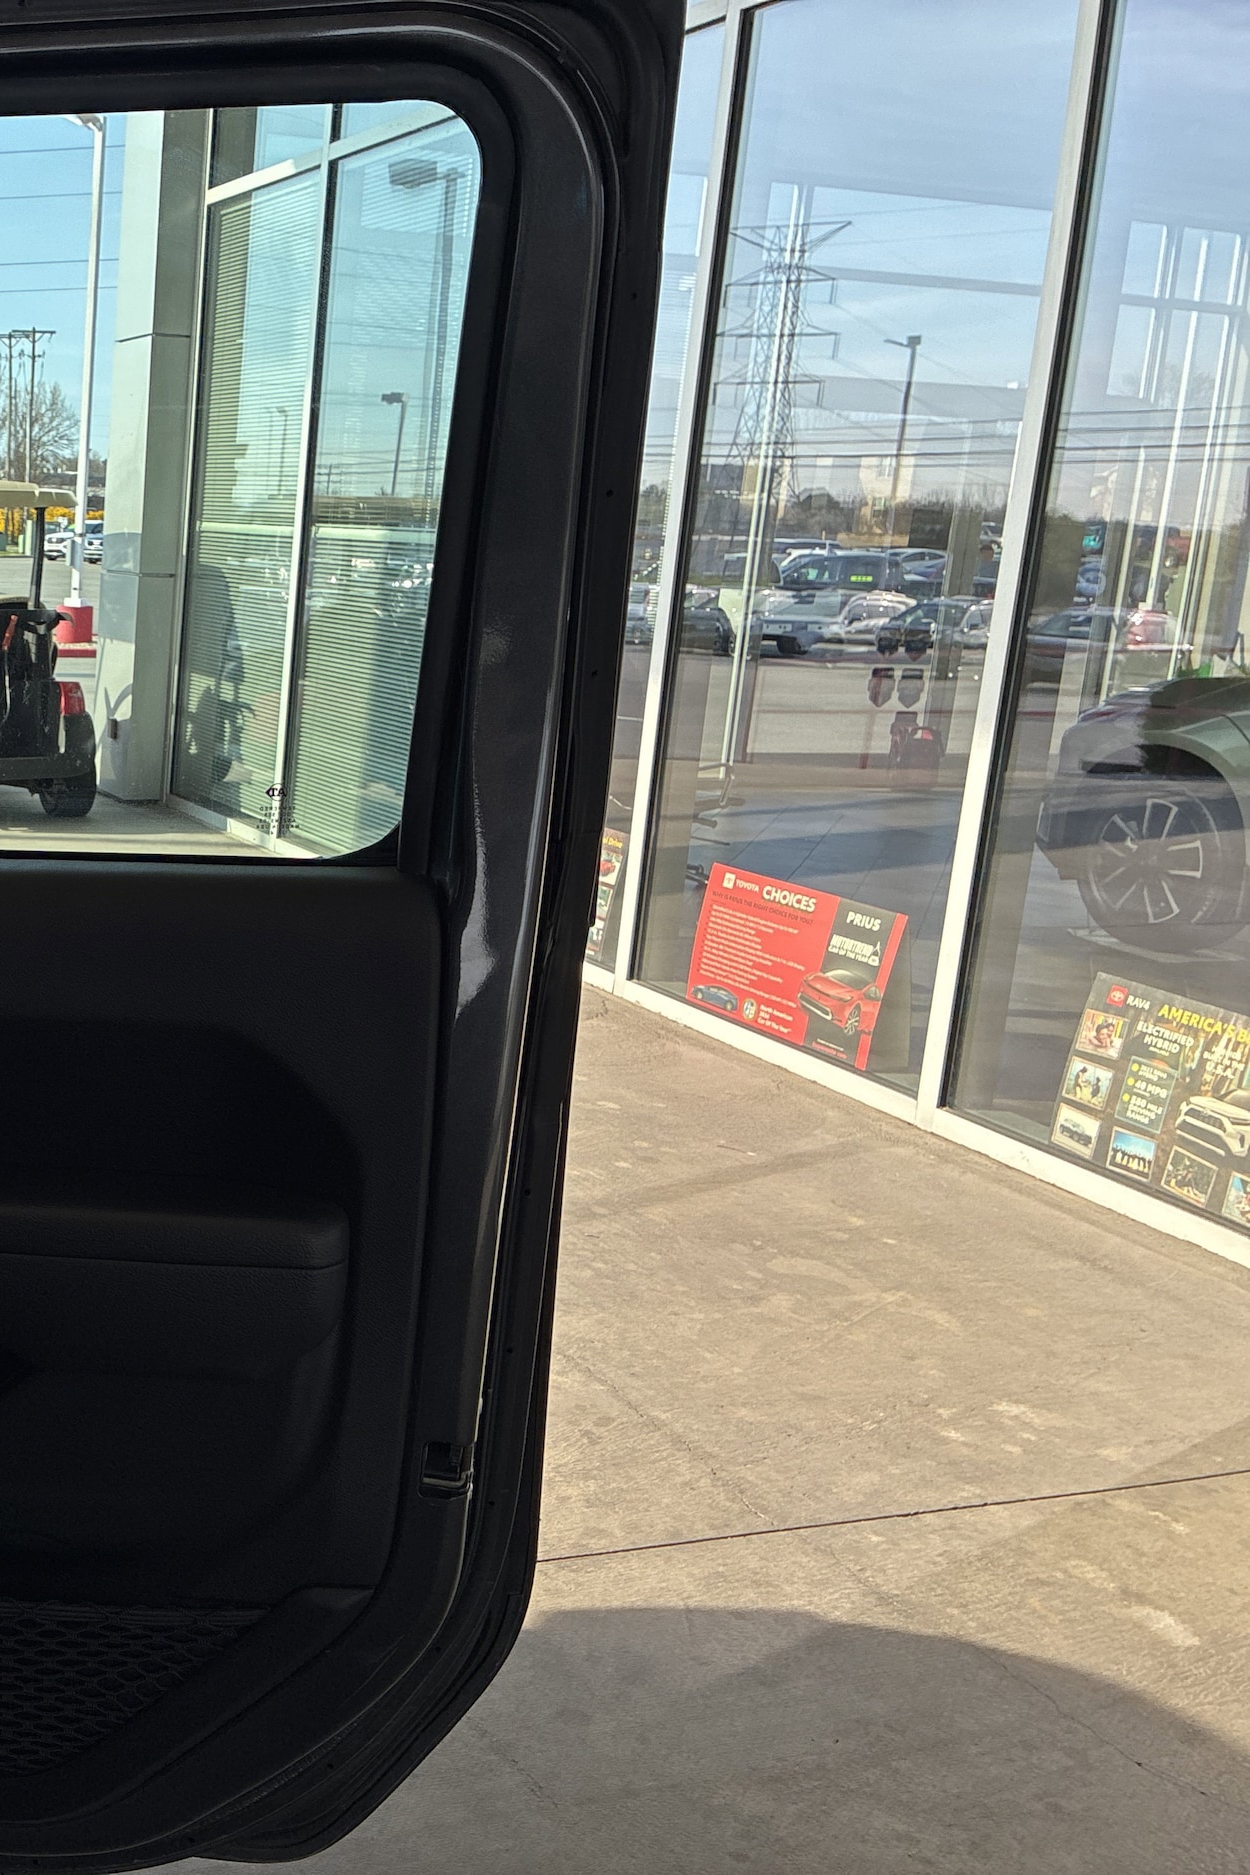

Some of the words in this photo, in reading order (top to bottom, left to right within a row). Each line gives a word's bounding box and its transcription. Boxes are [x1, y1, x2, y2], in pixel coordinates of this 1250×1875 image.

[735, 879, 760, 893] TOYOTA
[712, 890, 724, 900] WHY
[753, 902, 768, 913] RIGHT
[768, 906, 787, 918] CHOICE
[788, 912, 799, 921] FOR
[762, 885, 818, 913] CHOICES
[846, 911, 881, 931] PRIUS
[1126, 995, 1151, 1010] RAV4
[1158, 1004, 1236, 1038] AMERICA'S
[1136, 1021, 1195, 1047] ELECTRIFIED
[1143, 1035, 1180, 1053] HYBRID
[1134, 1080, 1147, 1090] 40
[1146, 1083, 1168, 1099] MPG
